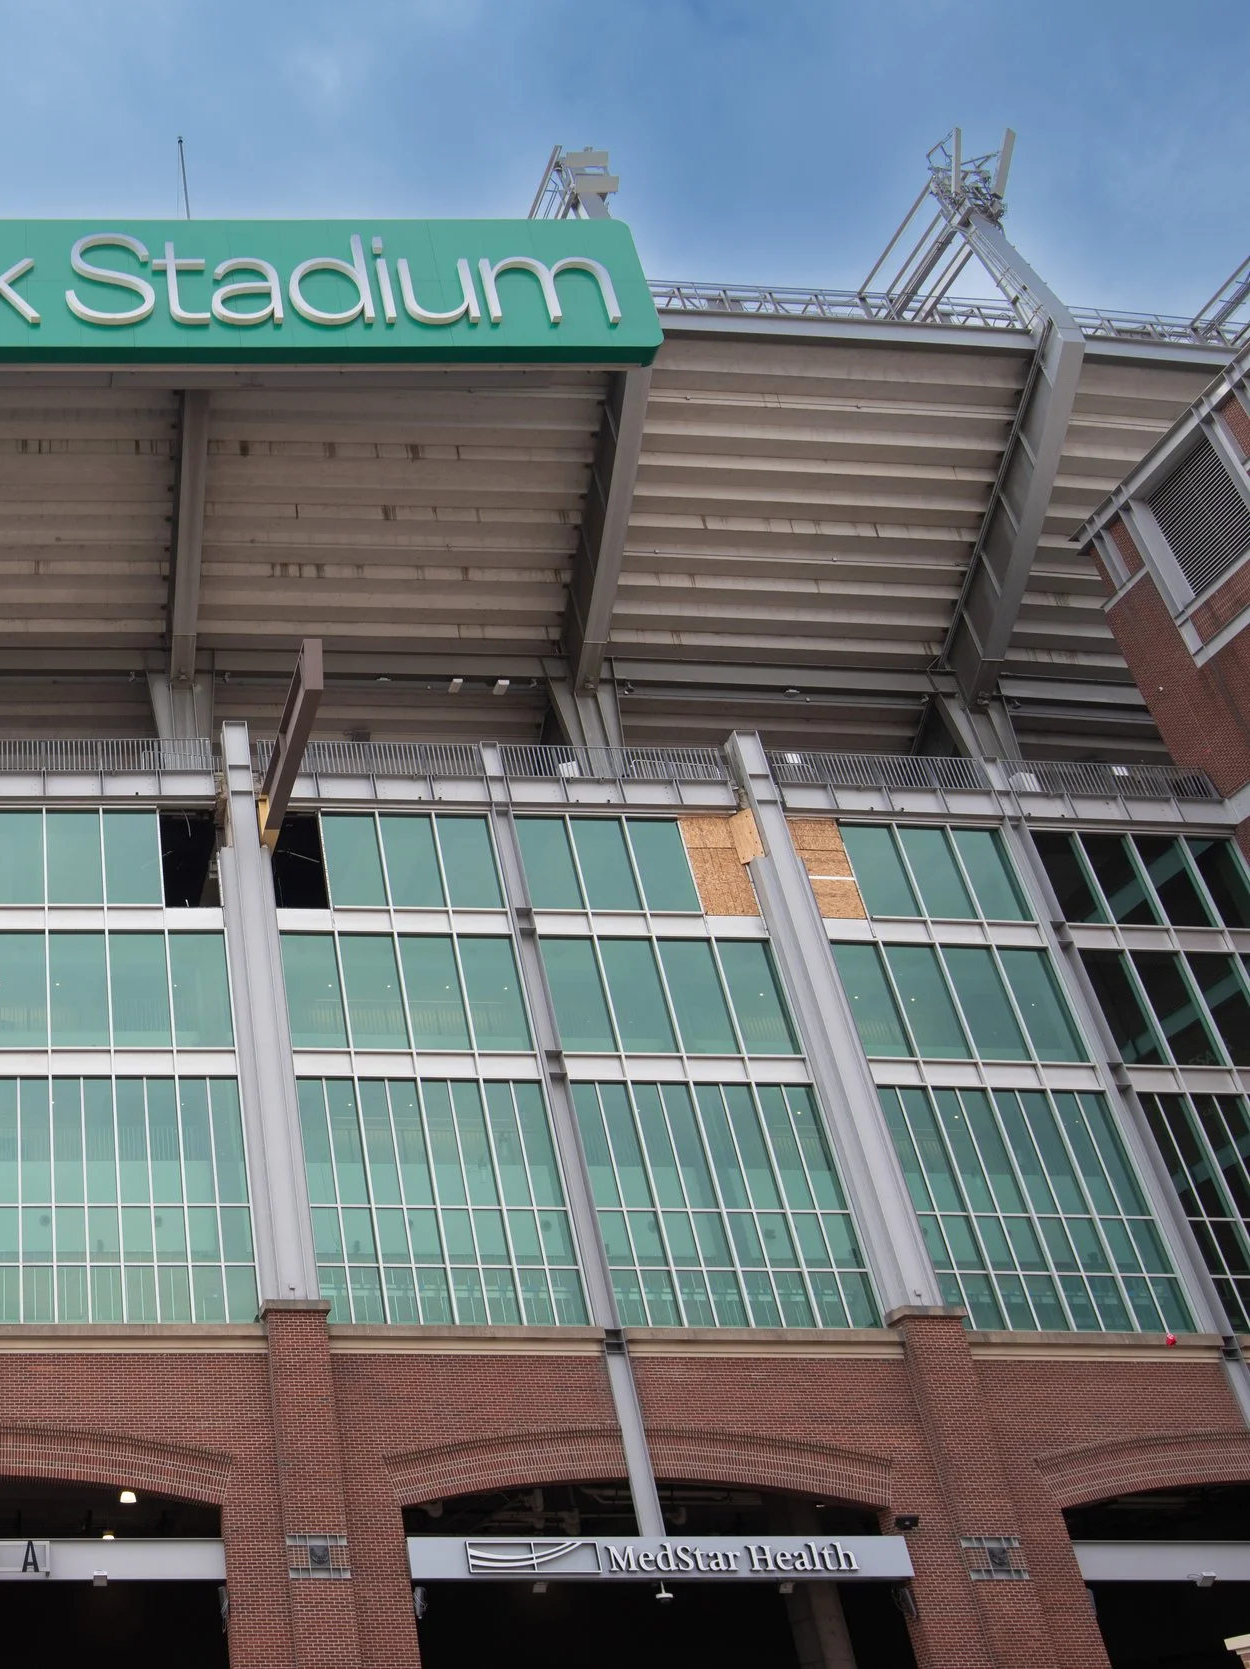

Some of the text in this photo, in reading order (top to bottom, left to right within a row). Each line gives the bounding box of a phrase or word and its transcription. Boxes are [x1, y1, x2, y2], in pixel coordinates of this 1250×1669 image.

[65, 232, 621, 325] Stadium
[21, 1540, 40, 1573] A
[607, 1541, 859, 1572] MedStar Health
